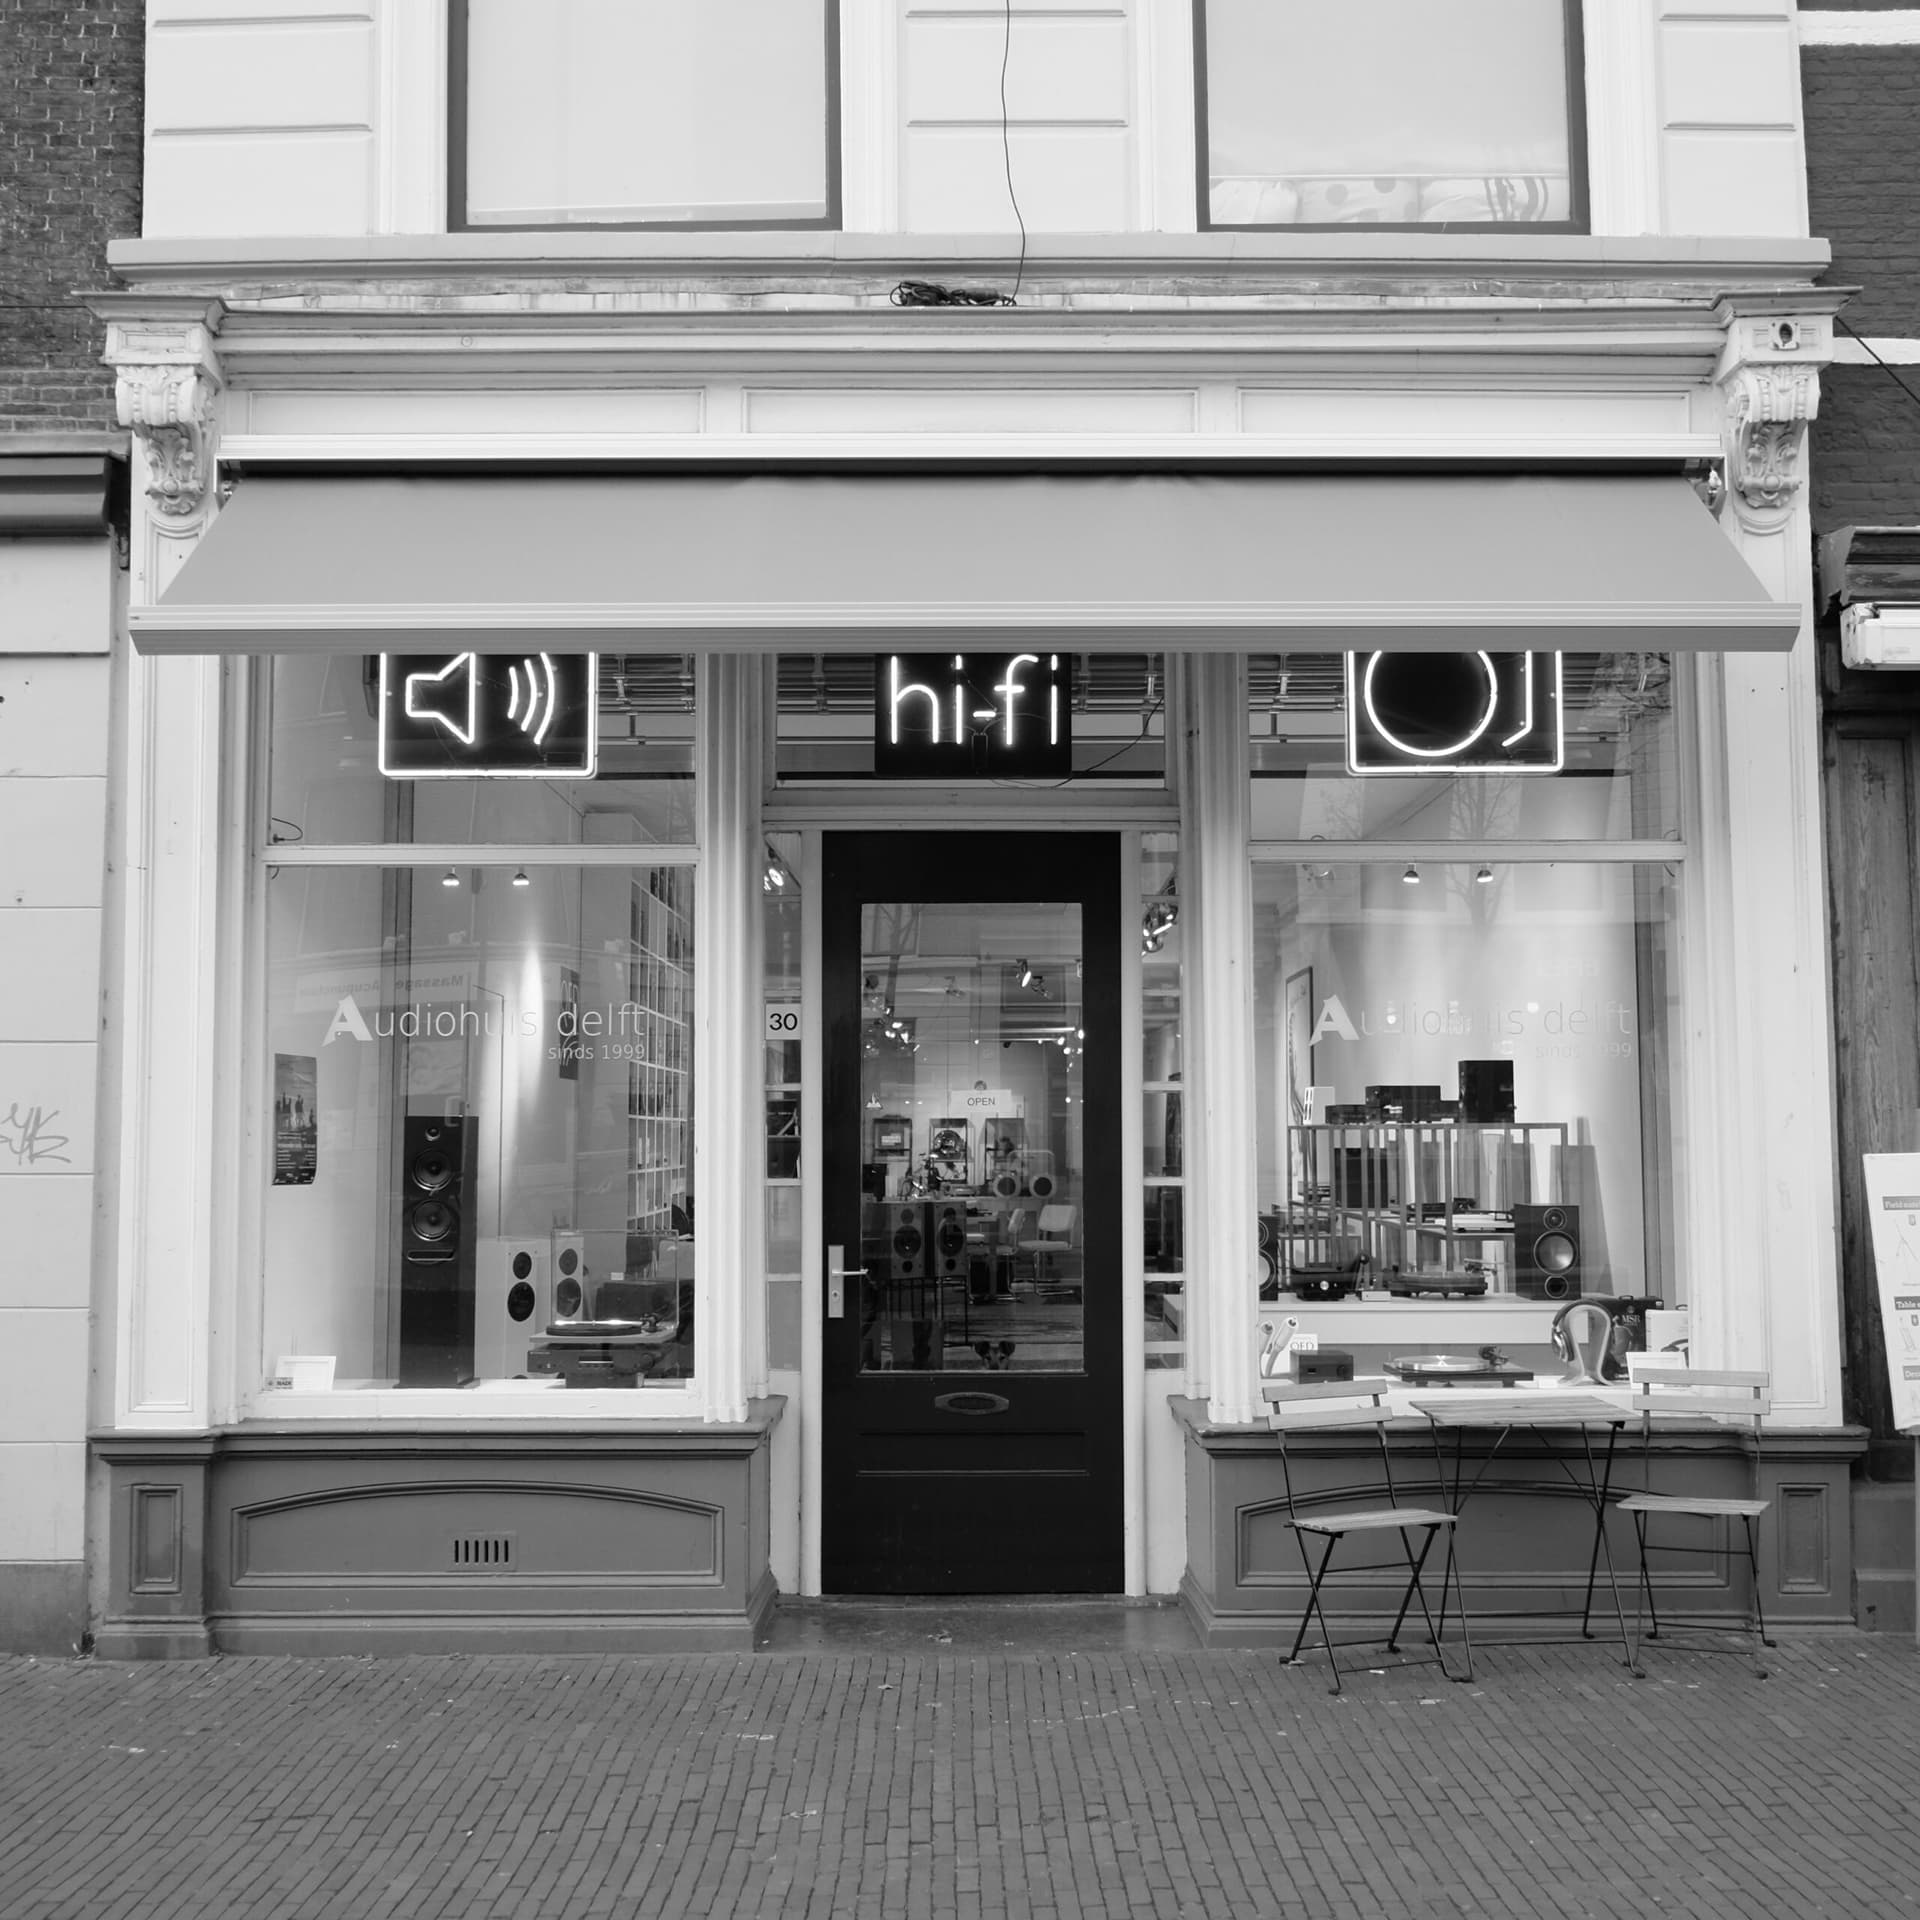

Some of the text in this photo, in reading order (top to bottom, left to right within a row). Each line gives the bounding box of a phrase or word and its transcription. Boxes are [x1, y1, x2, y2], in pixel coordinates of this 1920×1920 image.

[891, 654, 1058, 745] hi-fi
[321, 994, 645, 1047] Audiohuis delft
[769, 1012, 798, 1031] 30
[549, 1044, 645, 1060] sinds 1999
[967, 1096, 996, 1106] OPEN
[1895, 1300, 1916, 1308] Table
